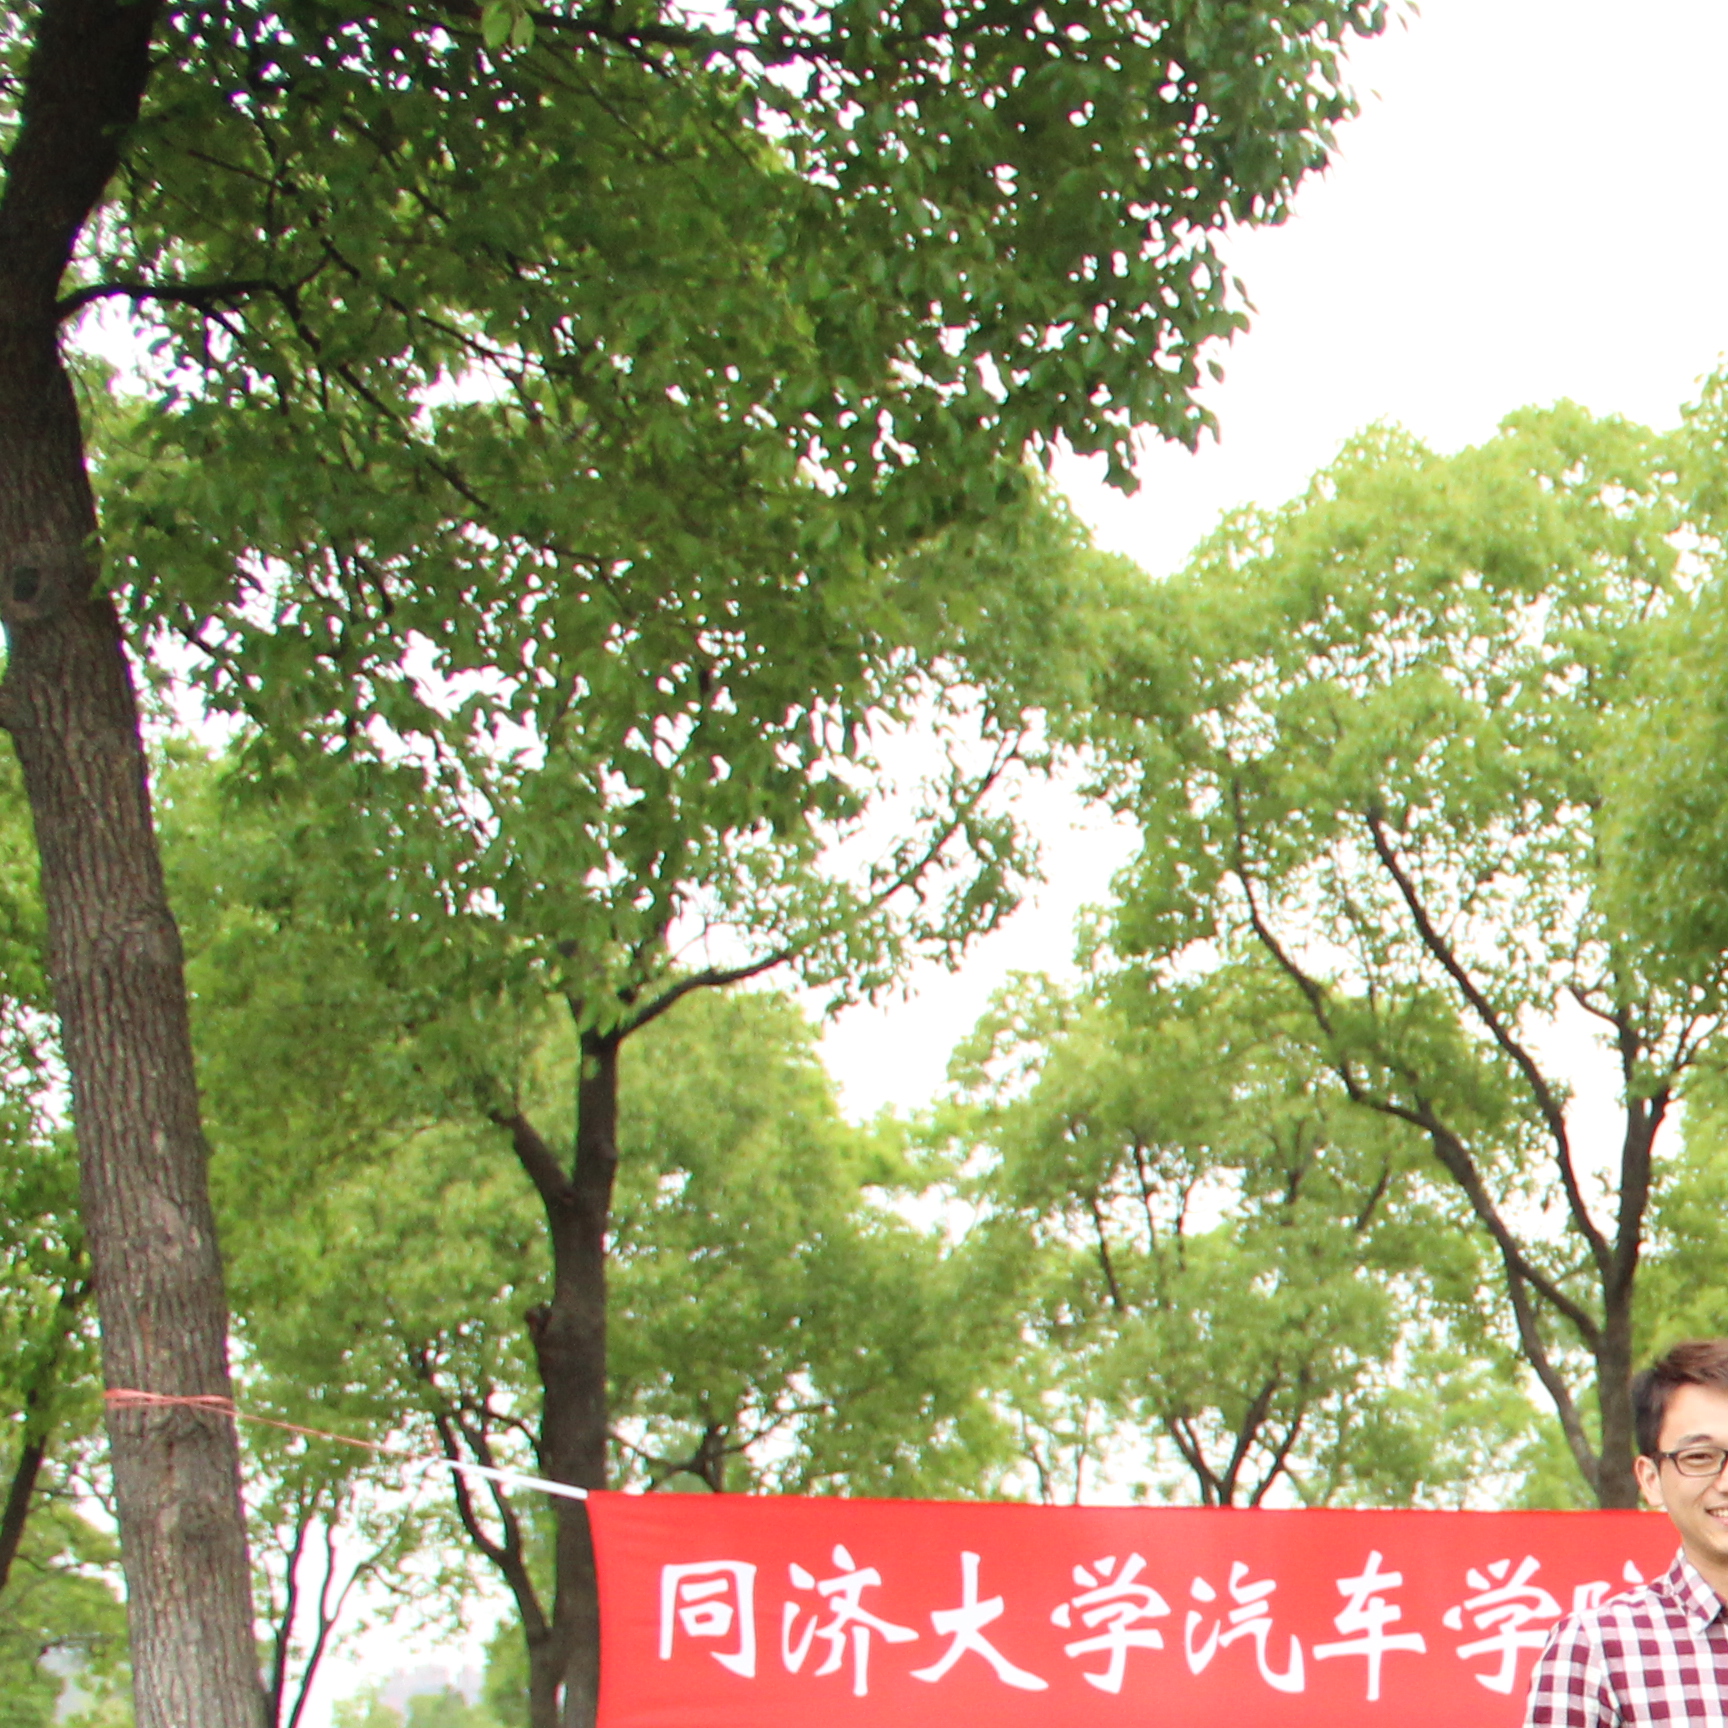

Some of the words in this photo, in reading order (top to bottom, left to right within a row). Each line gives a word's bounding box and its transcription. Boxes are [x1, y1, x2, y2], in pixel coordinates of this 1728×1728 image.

[660, 1543, 1645, 1702] 同济大学汽车学
